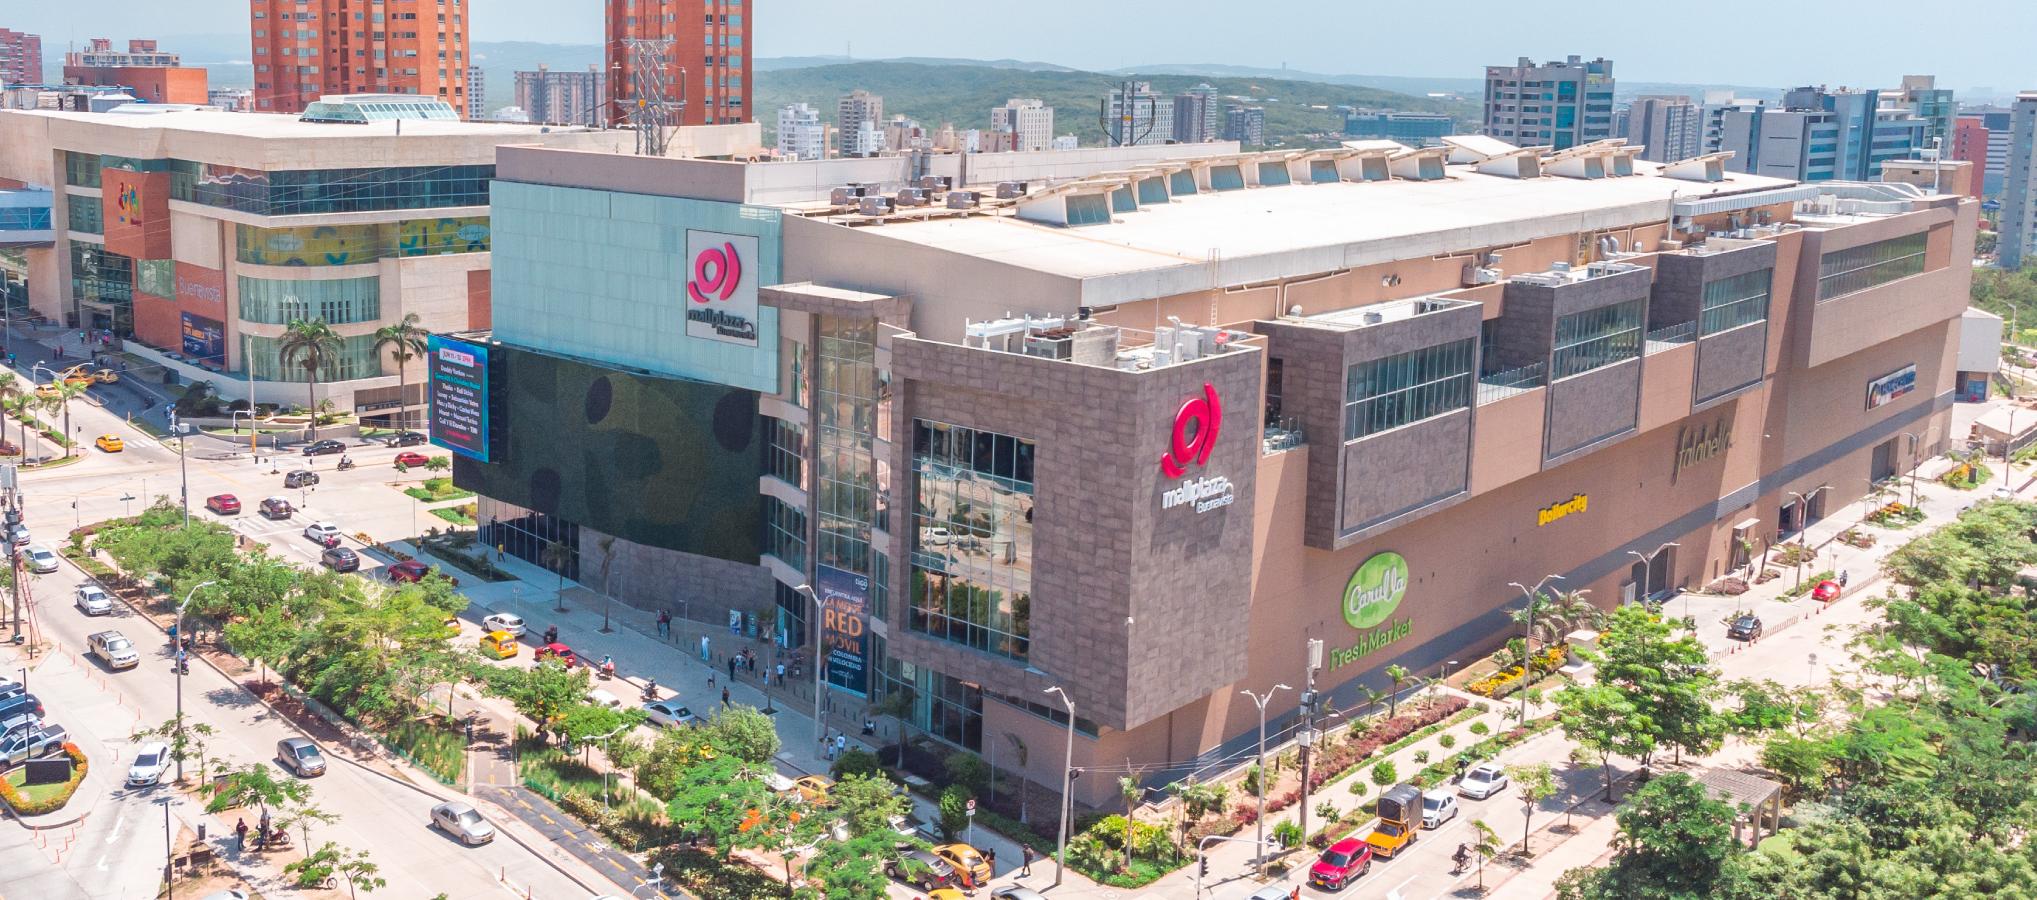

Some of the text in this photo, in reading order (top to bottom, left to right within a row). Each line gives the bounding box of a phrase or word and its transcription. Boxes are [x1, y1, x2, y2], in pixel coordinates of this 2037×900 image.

[179, 276, 220, 302] Buenavista
[688, 308, 745, 328] mallplaza
[1162, 476, 1227, 509] mallplaza
[1539, 495, 1588, 527] Dollarcity
[855, 578, 868, 590] tigo
[1349, 566, 1405, 614] Carulla
[825, 608, 863, 637] RED
